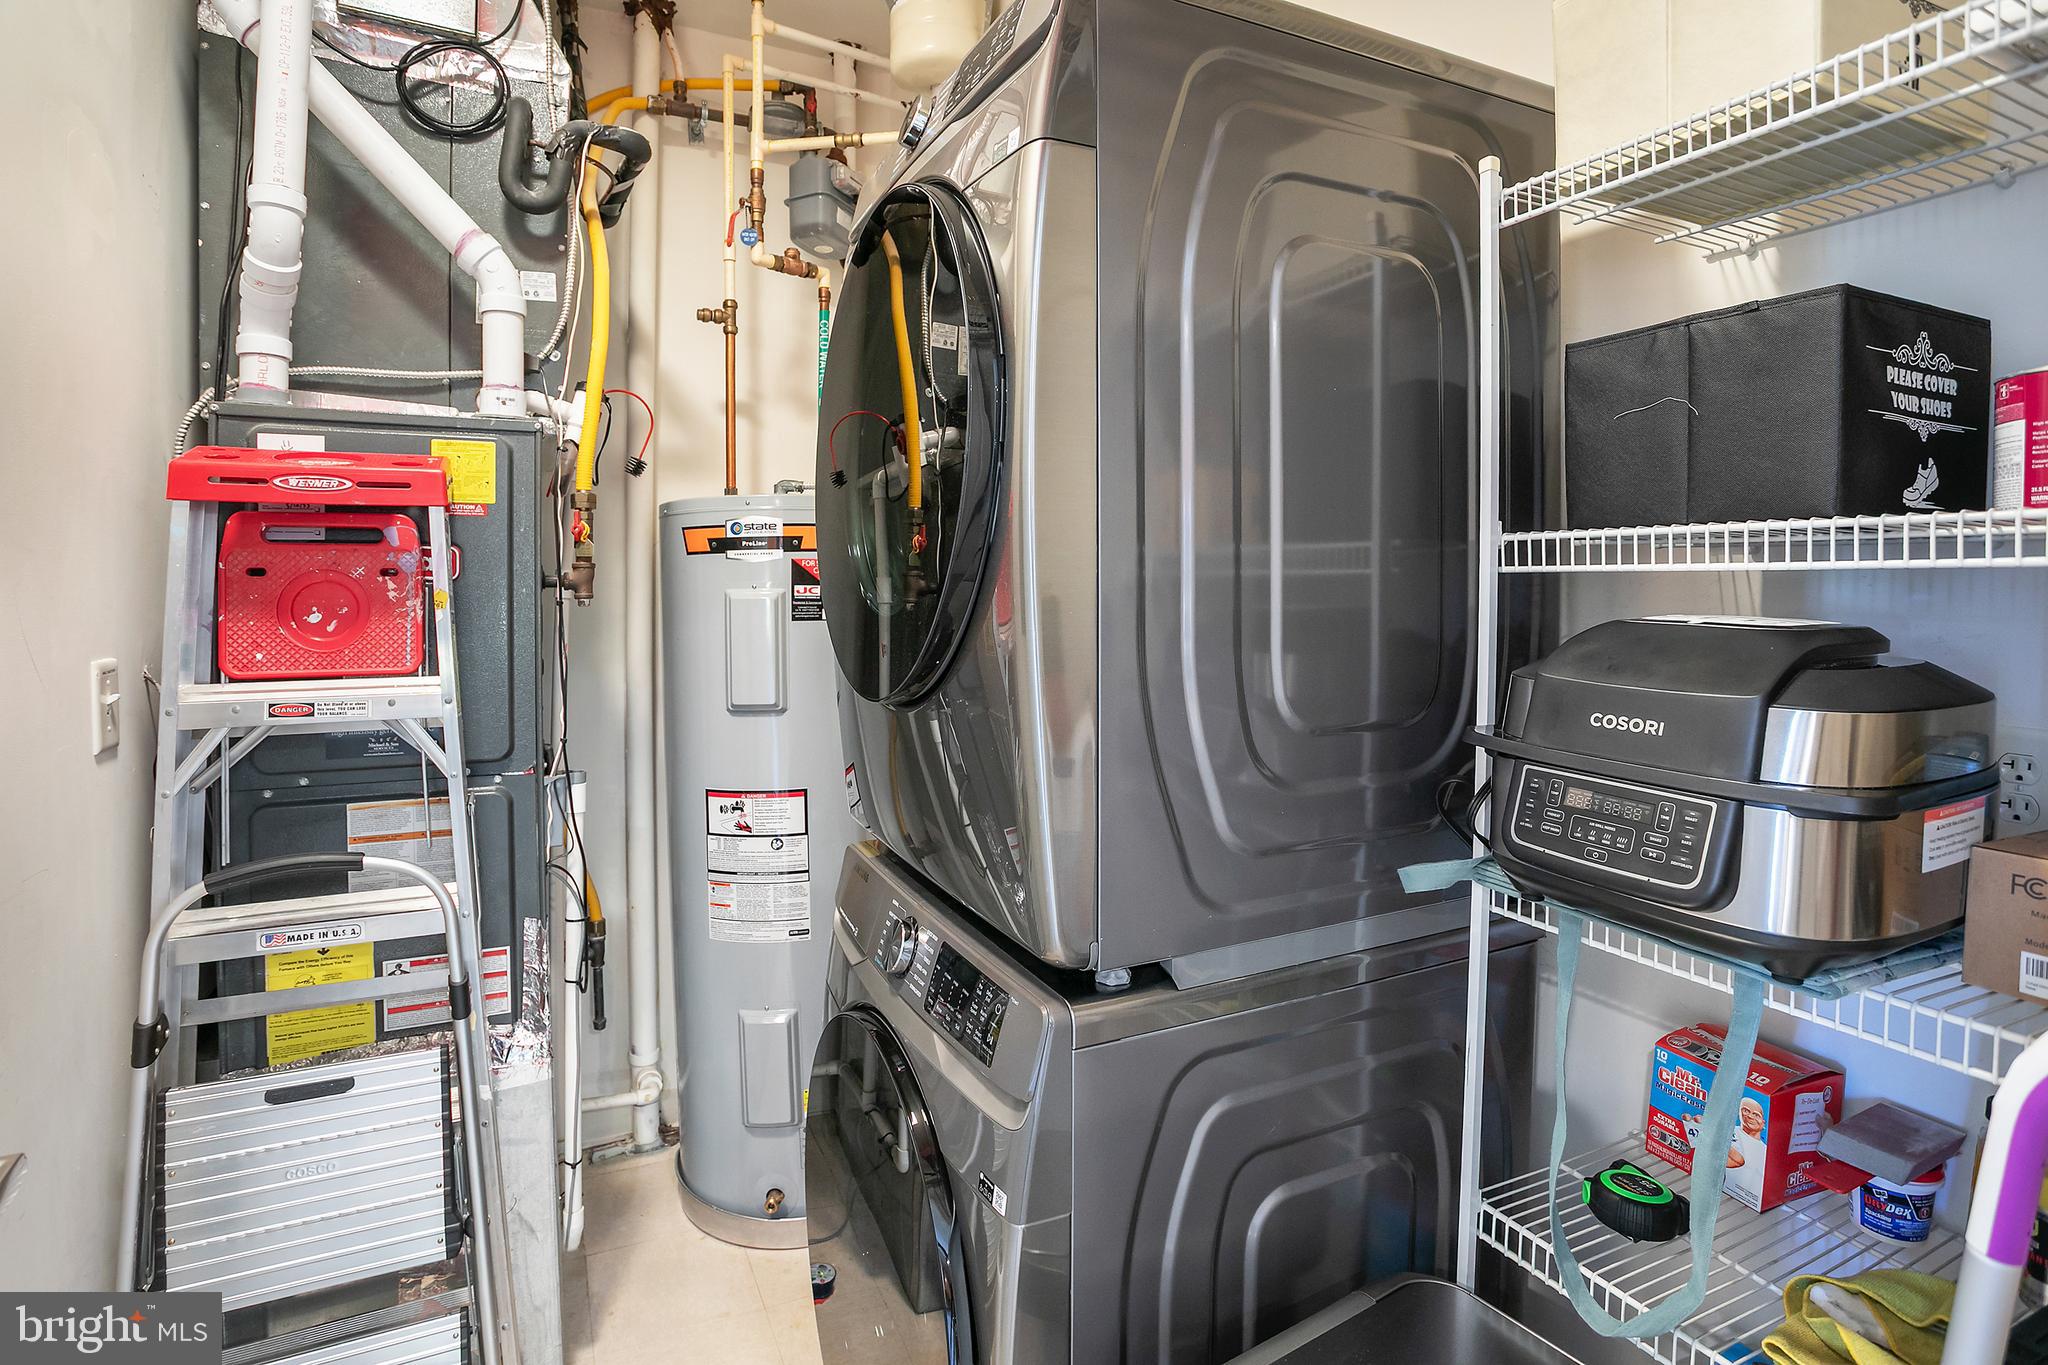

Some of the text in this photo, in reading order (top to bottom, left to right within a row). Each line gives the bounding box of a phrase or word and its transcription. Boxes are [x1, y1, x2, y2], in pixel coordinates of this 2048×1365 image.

[819, 319, 829, 348] COLD
[1886, 365, 1958, 396] PLEASE COVER
[1890, 390, 1952, 419] YOUR SHOES
[287, 478, 339, 489] WERNER
[743, 522, 777, 531] state
[274, 706, 309, 714] DANGER
[1590, 712, 1665, 737] COSORI
[287, 933, 314, 942] MADE
[319, 930, 328, 939] IN
[1656, 1048, 1668, 1060] 10
[1658, 1066, 1707, 1101] Clean
[1675, 1065, 1701, 1087] Mr.
[1747, 1071, 1771, 1085] 10
[1653, 1116, 1679, 1134] DURABLE
[1657, 1113, 1676, 1126] EXTRA
[1864, 1207, 1892, 1223] Spackling
